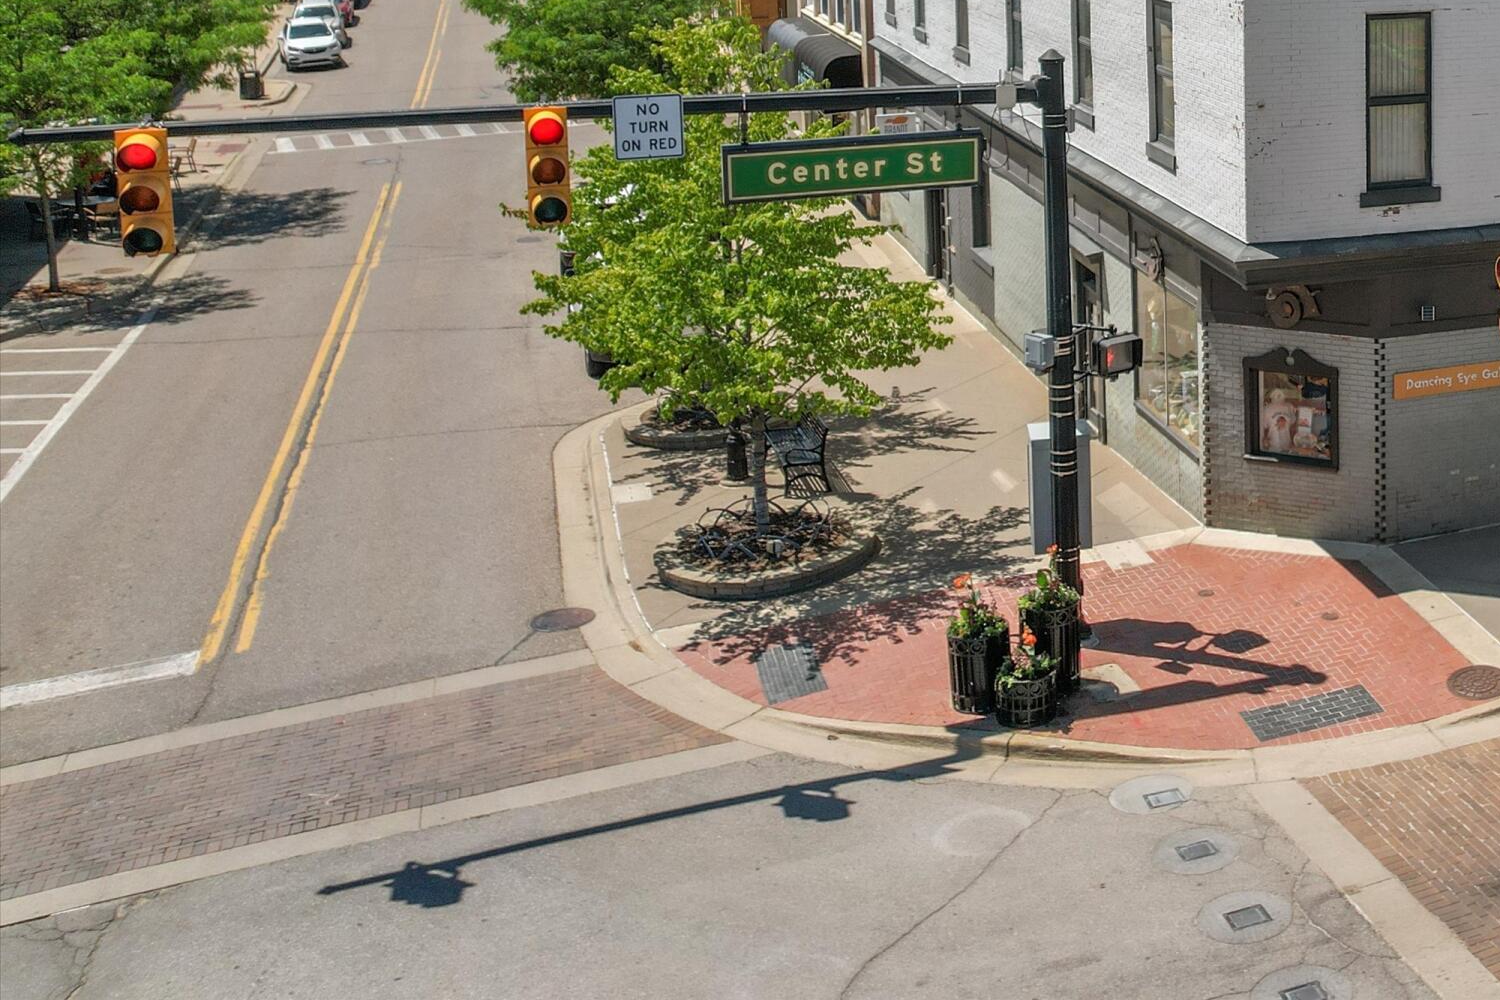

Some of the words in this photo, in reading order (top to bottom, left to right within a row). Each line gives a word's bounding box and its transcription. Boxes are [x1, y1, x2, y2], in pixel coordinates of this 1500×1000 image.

[636, 103, 659, 116] NO
[629, 120, 668, 134] TURN
[622, 139, 641, 152] ON
[649, 137, 677, 150] RED
[767, 158, 886, 185] Center
[906, 151, 942, 174] St
[1406, 376, 1452, 390] Dancing
[1457, 373, 1478, 384] Eye
